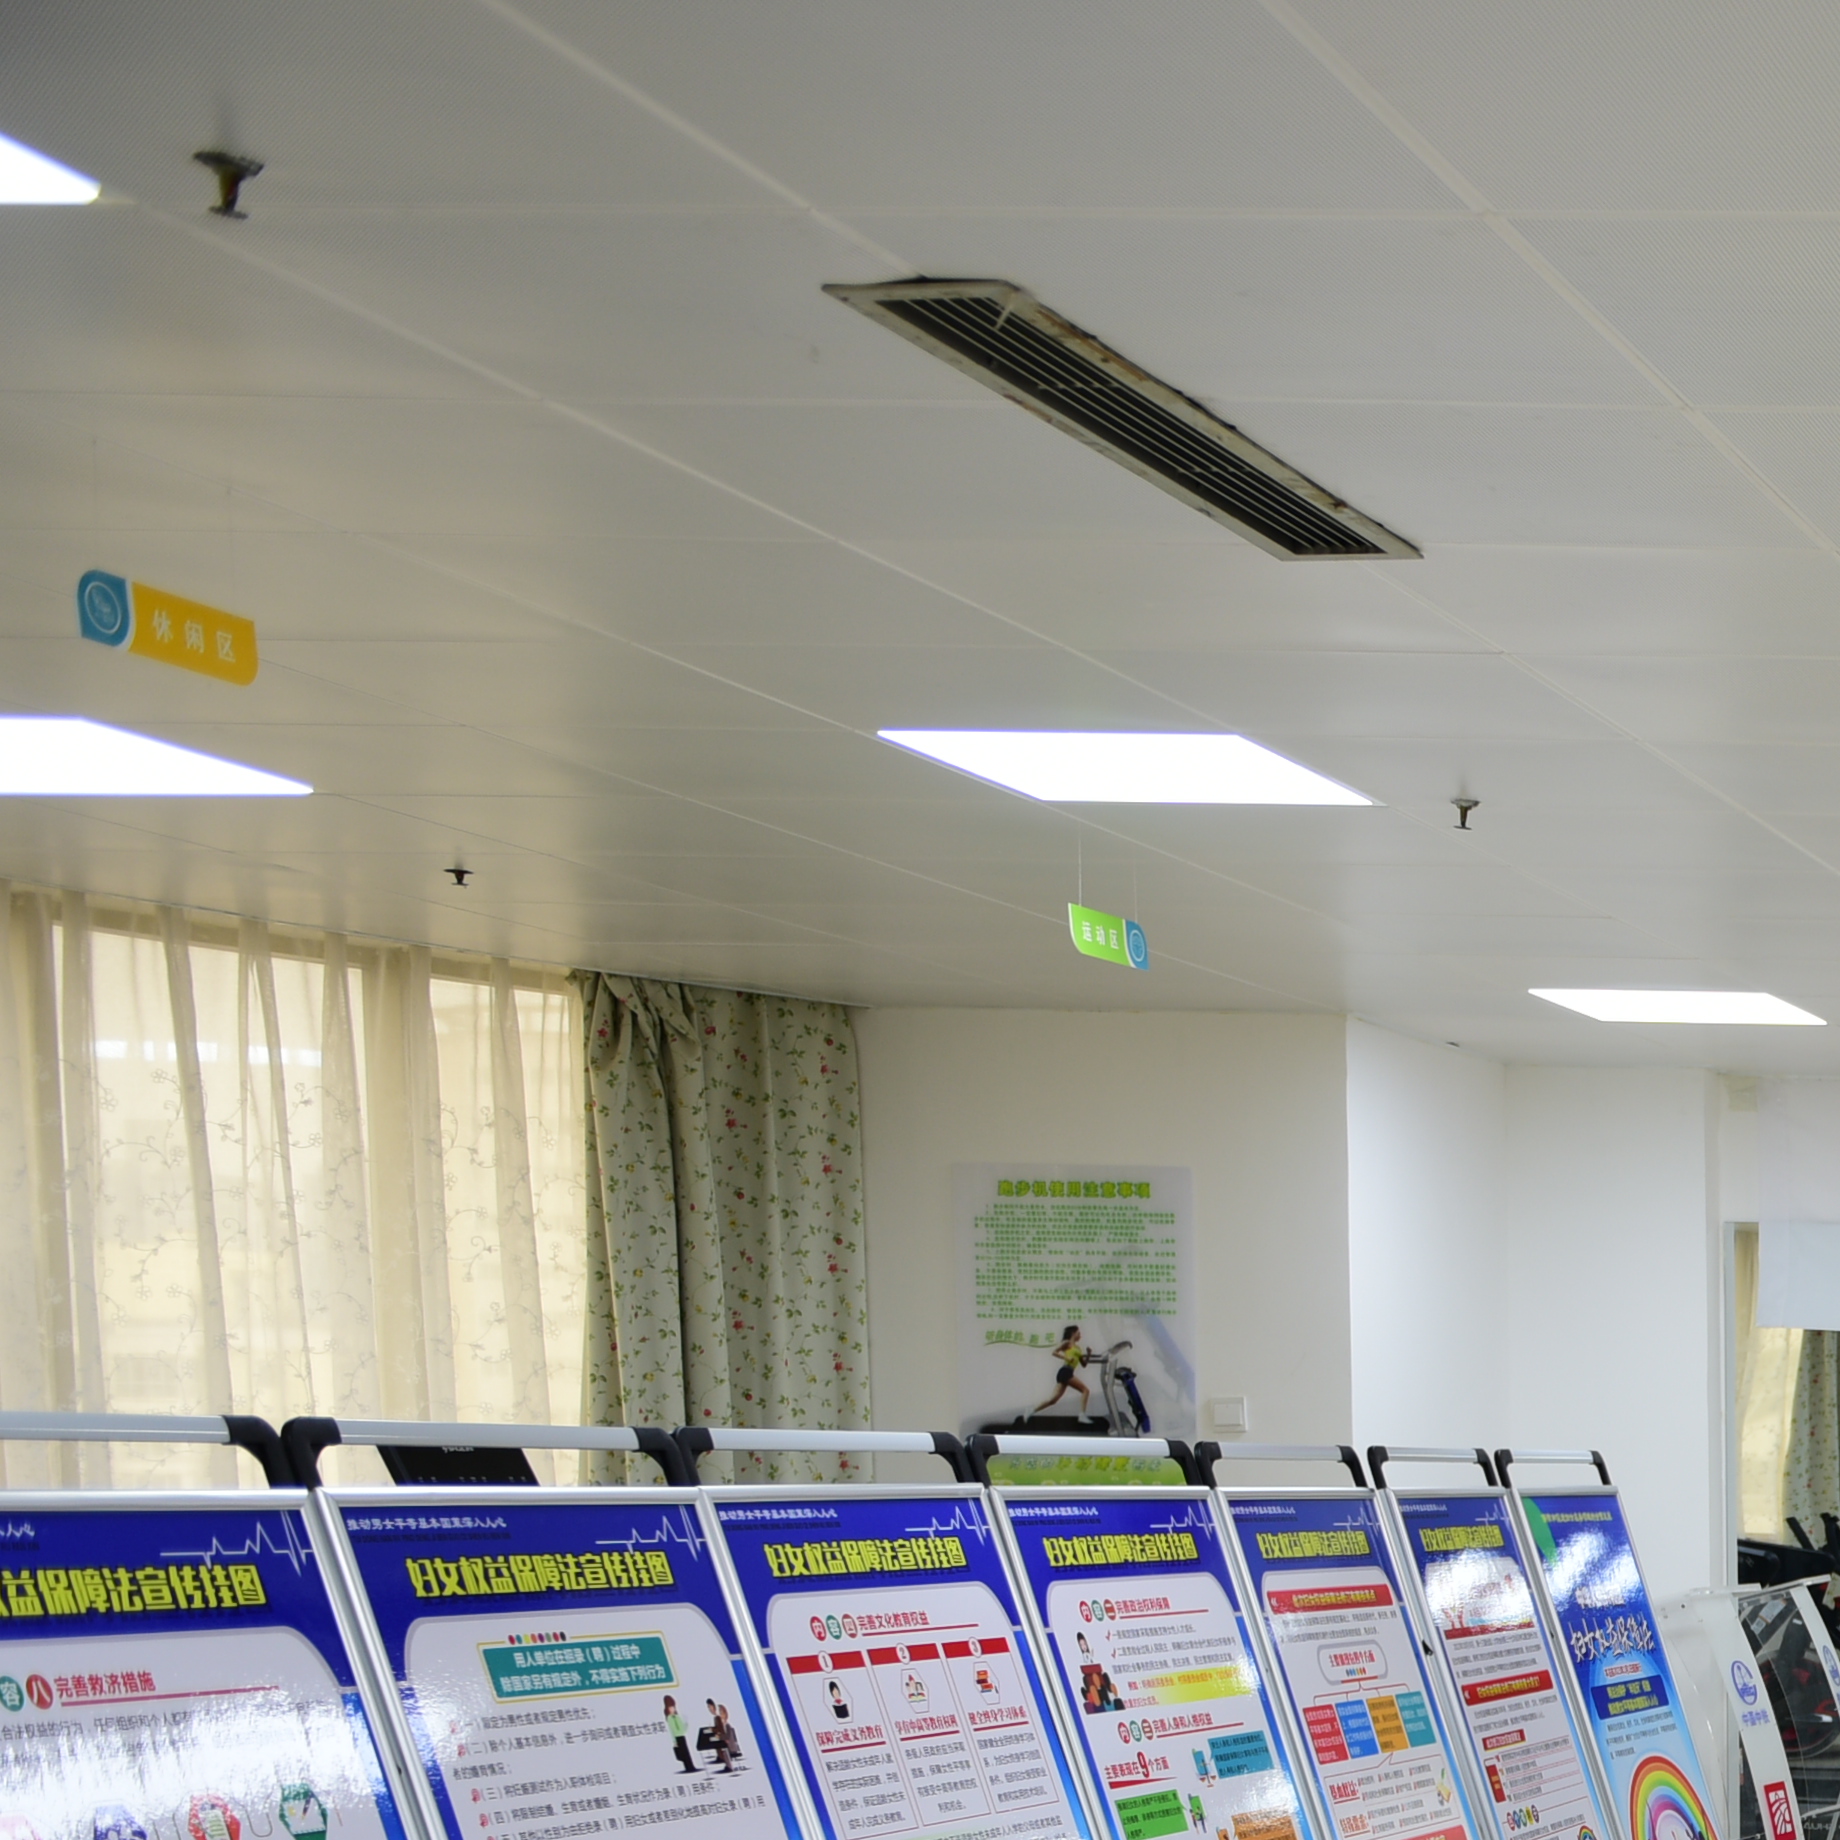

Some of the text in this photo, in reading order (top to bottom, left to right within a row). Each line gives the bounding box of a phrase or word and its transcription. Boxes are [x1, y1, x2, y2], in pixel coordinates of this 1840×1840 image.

[153, 609, 236, 662] 休闲区
[764, 1536, 967, 1578] 妇女权益保障法宣传挂图
[1043, 1533, 1199, 1567] 妇女权益保障法宣传挂图
[0, 1564, 267, 1617] 益保障法宣传挂图
[406, 1551, 674, 1598] 妇女权益保障法宣传挂图
[857, 1611, 931, 1631] 完善文化教育权益
[54, 1670, 156, 1699] 完善救济措施
[816, 1724, 884, 1746] 保障完成义务教育
